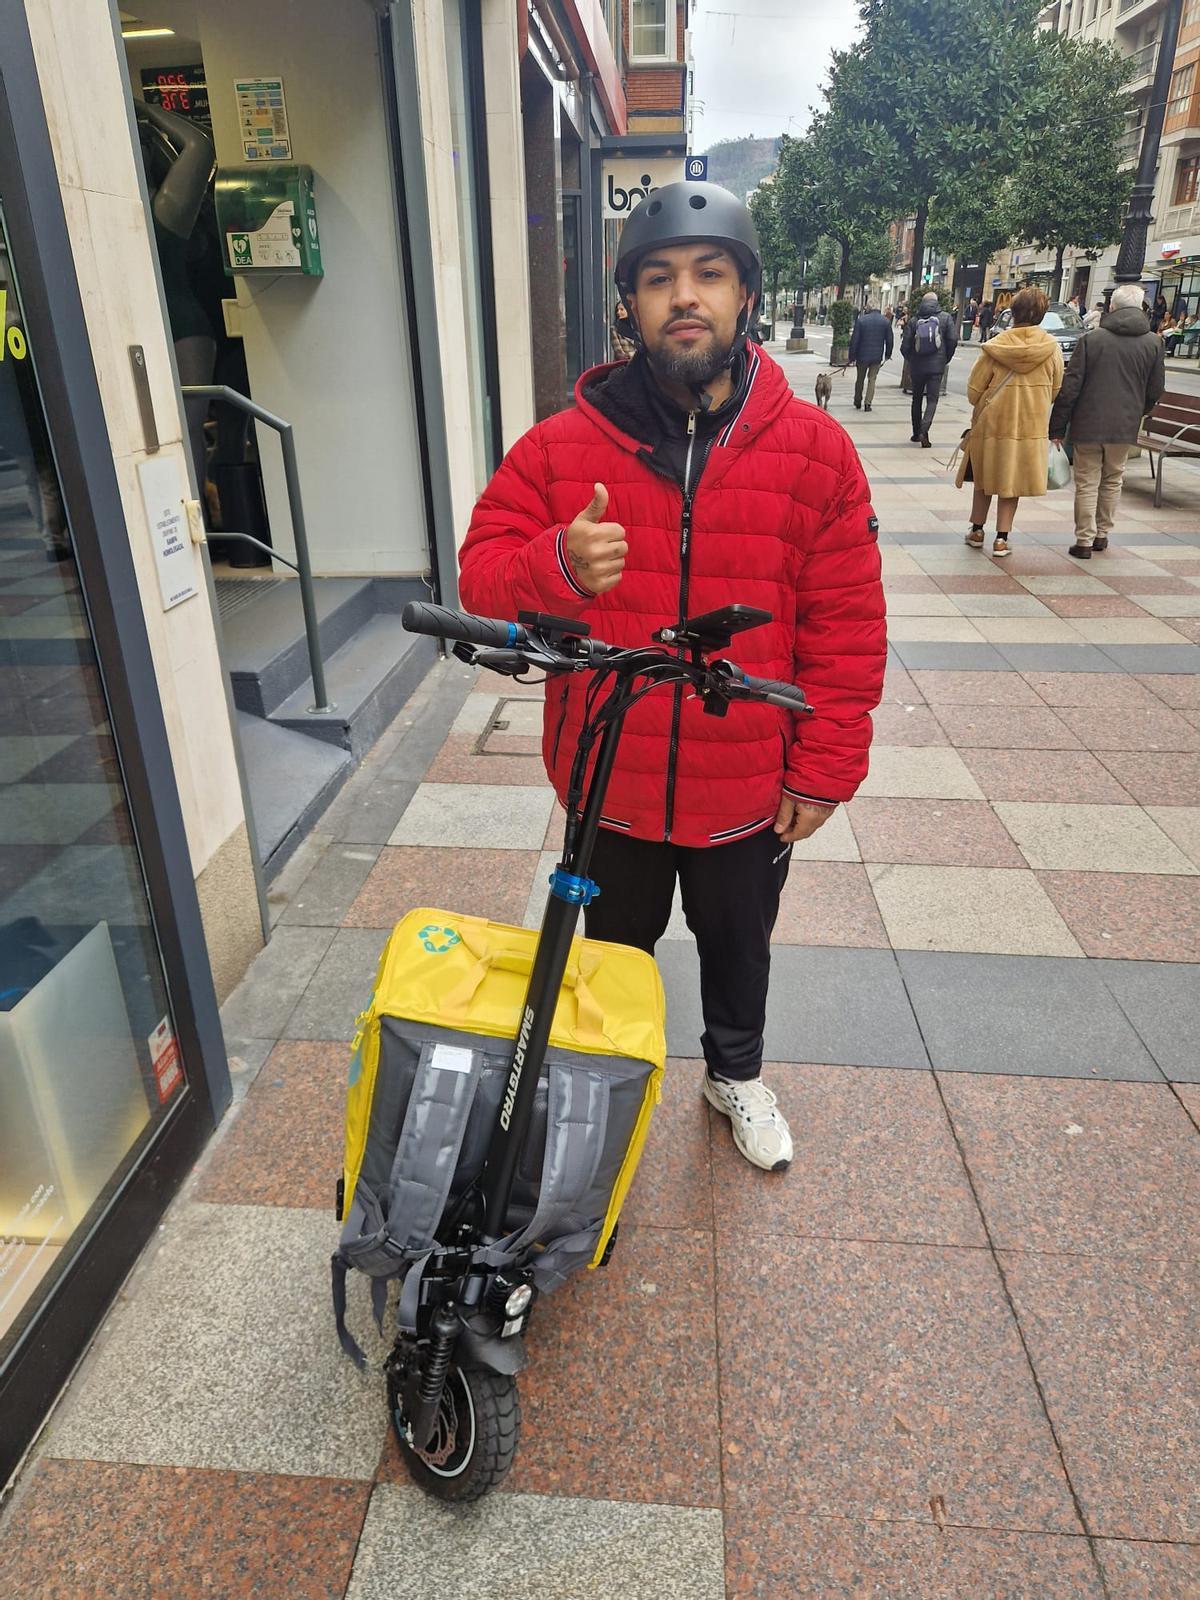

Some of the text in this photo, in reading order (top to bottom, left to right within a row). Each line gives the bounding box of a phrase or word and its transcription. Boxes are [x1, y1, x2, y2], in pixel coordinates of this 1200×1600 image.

[607, 174, 660, 211] bri
[235, 256, 253, 265] DEA
[500, 1005, 534, 1131] SMARTGYRO
